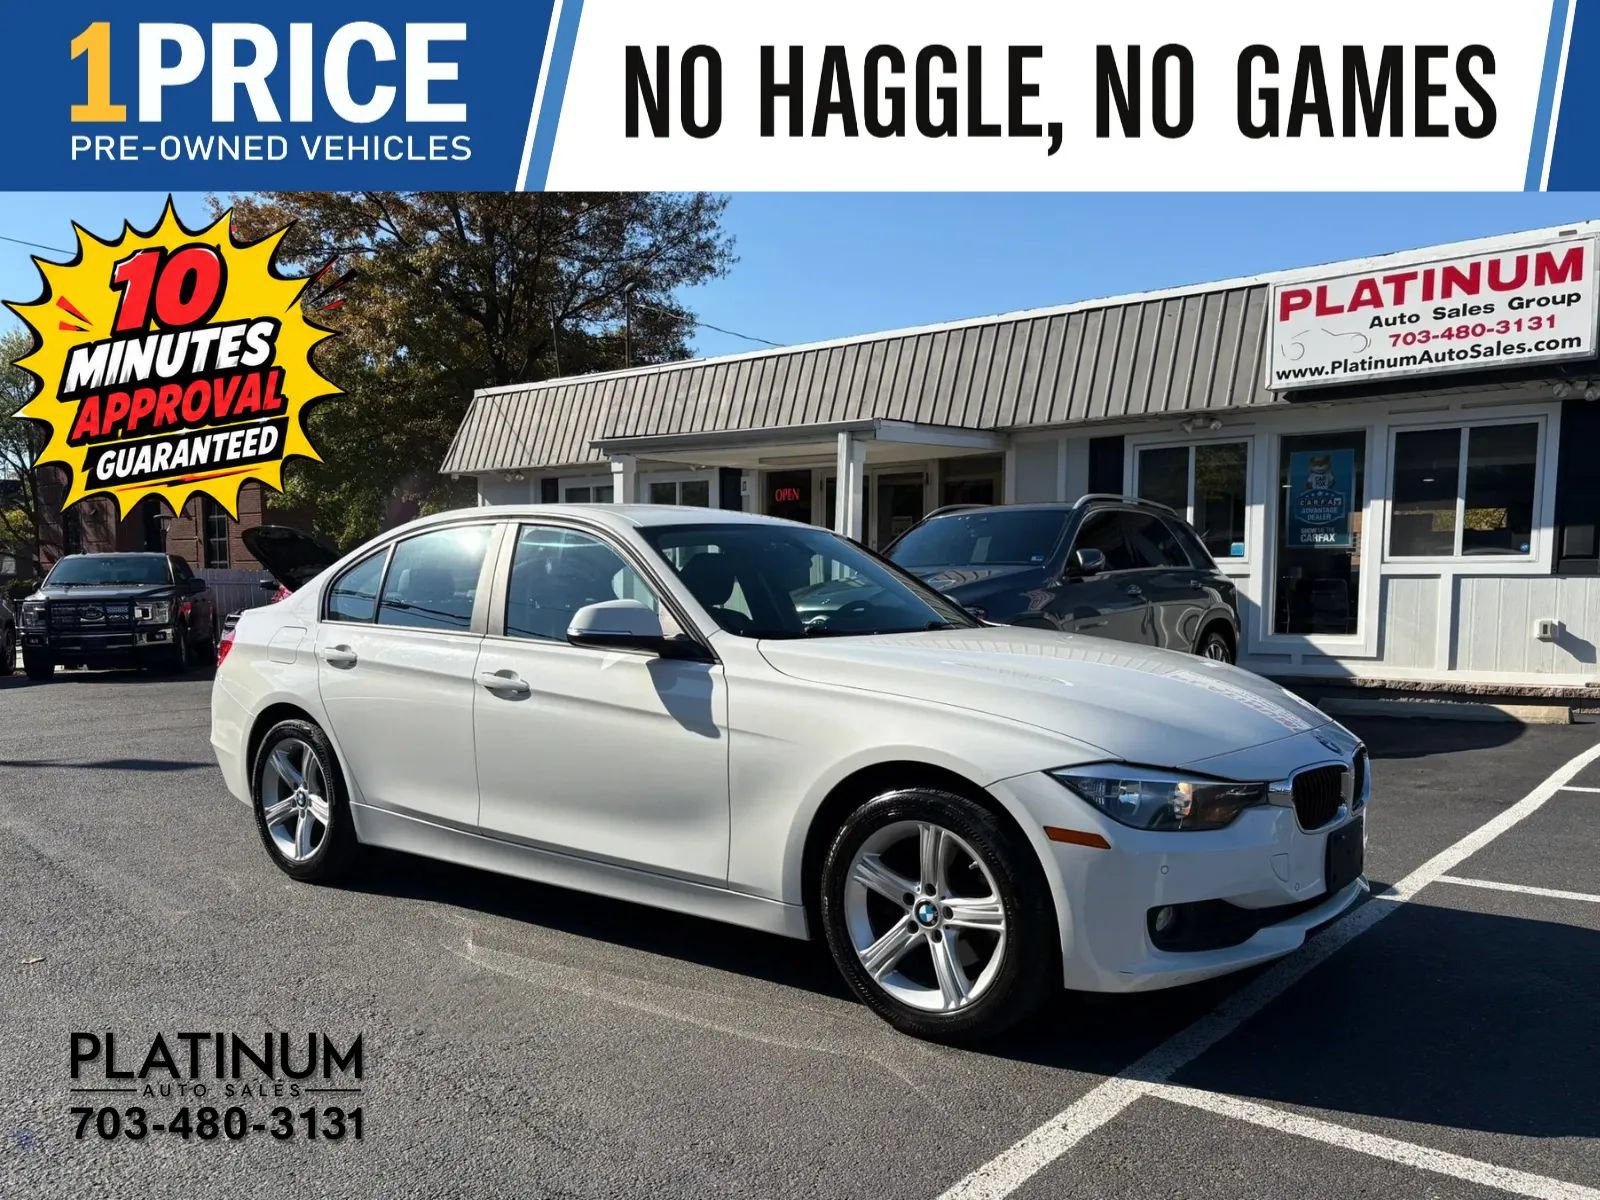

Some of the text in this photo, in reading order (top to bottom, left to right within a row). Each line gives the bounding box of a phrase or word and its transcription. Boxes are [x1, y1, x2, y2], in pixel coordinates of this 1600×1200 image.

[1279, 246, 1585, 322] PLATINUM
[1369, 291, 1582, 329] Auto Sales Group
[1389, 314, 1556, 347] 703-480-3131
[1276, 336, 1583, 380] www.PlatinumAutoSales.com
[775, 487, 800, 502] OPEN
[1300, 533, 1336, 543] CARFAX
